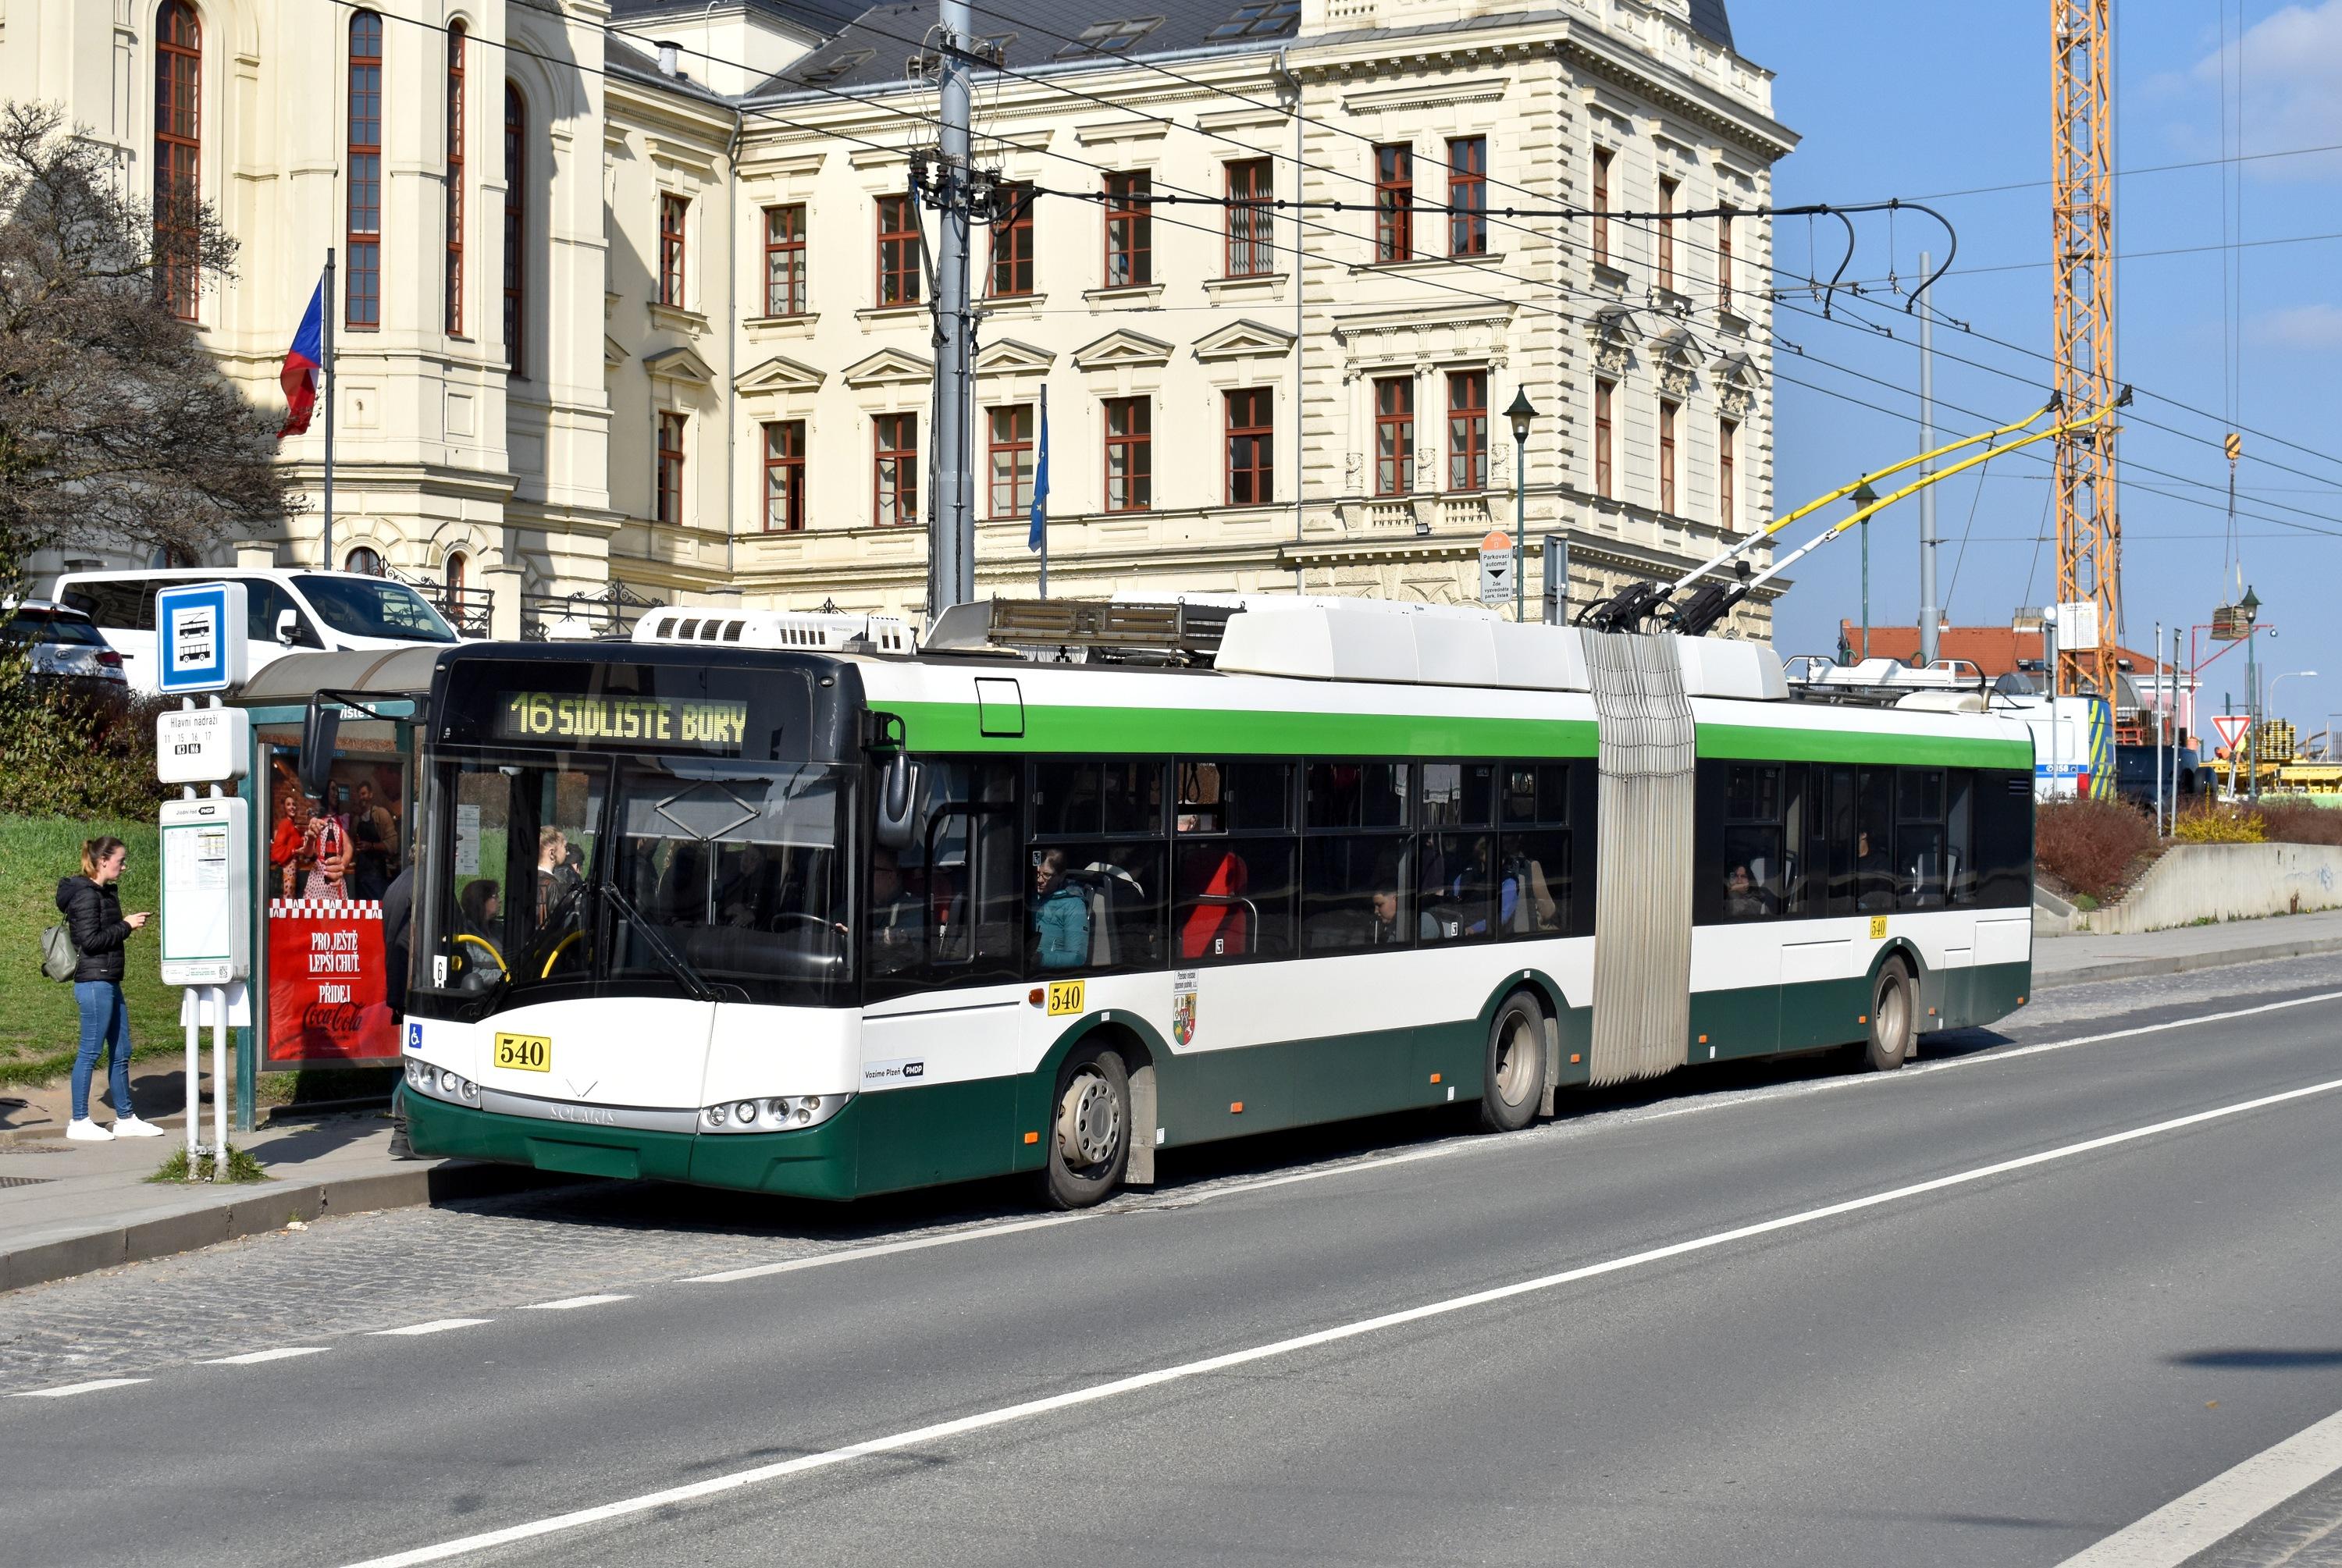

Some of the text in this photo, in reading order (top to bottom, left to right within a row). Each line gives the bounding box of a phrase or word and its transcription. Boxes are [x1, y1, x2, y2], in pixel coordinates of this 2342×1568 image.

[170, 714, 219, 728] Hlavní nádraží
[511, 692, 553, 734] 16
[682, 704, 747, 742] BORY
[164, 731, 212, 744] 11 15 16 17
[176, 744, 200, 755] N3 N6
[1871, 919, 1885, 936] 540
[311, 930, 358, 951] PRO JEŠTĚ
[309, 951, 334, 972] LEPŠÍ
[438, 962, 443, 980] 6
[319, 982, 351, 1004] PŘIDEJ
[1052, 986, 1080, 1011] 540
[301, 1001, 366, 1032] Coca-Cola
[500, 1038, 544, 1066] 540
[865, 1065, 923, 1079] Vozíme Plzeň PMDP
[550, 1104, 616, 1125] SOLARIS
